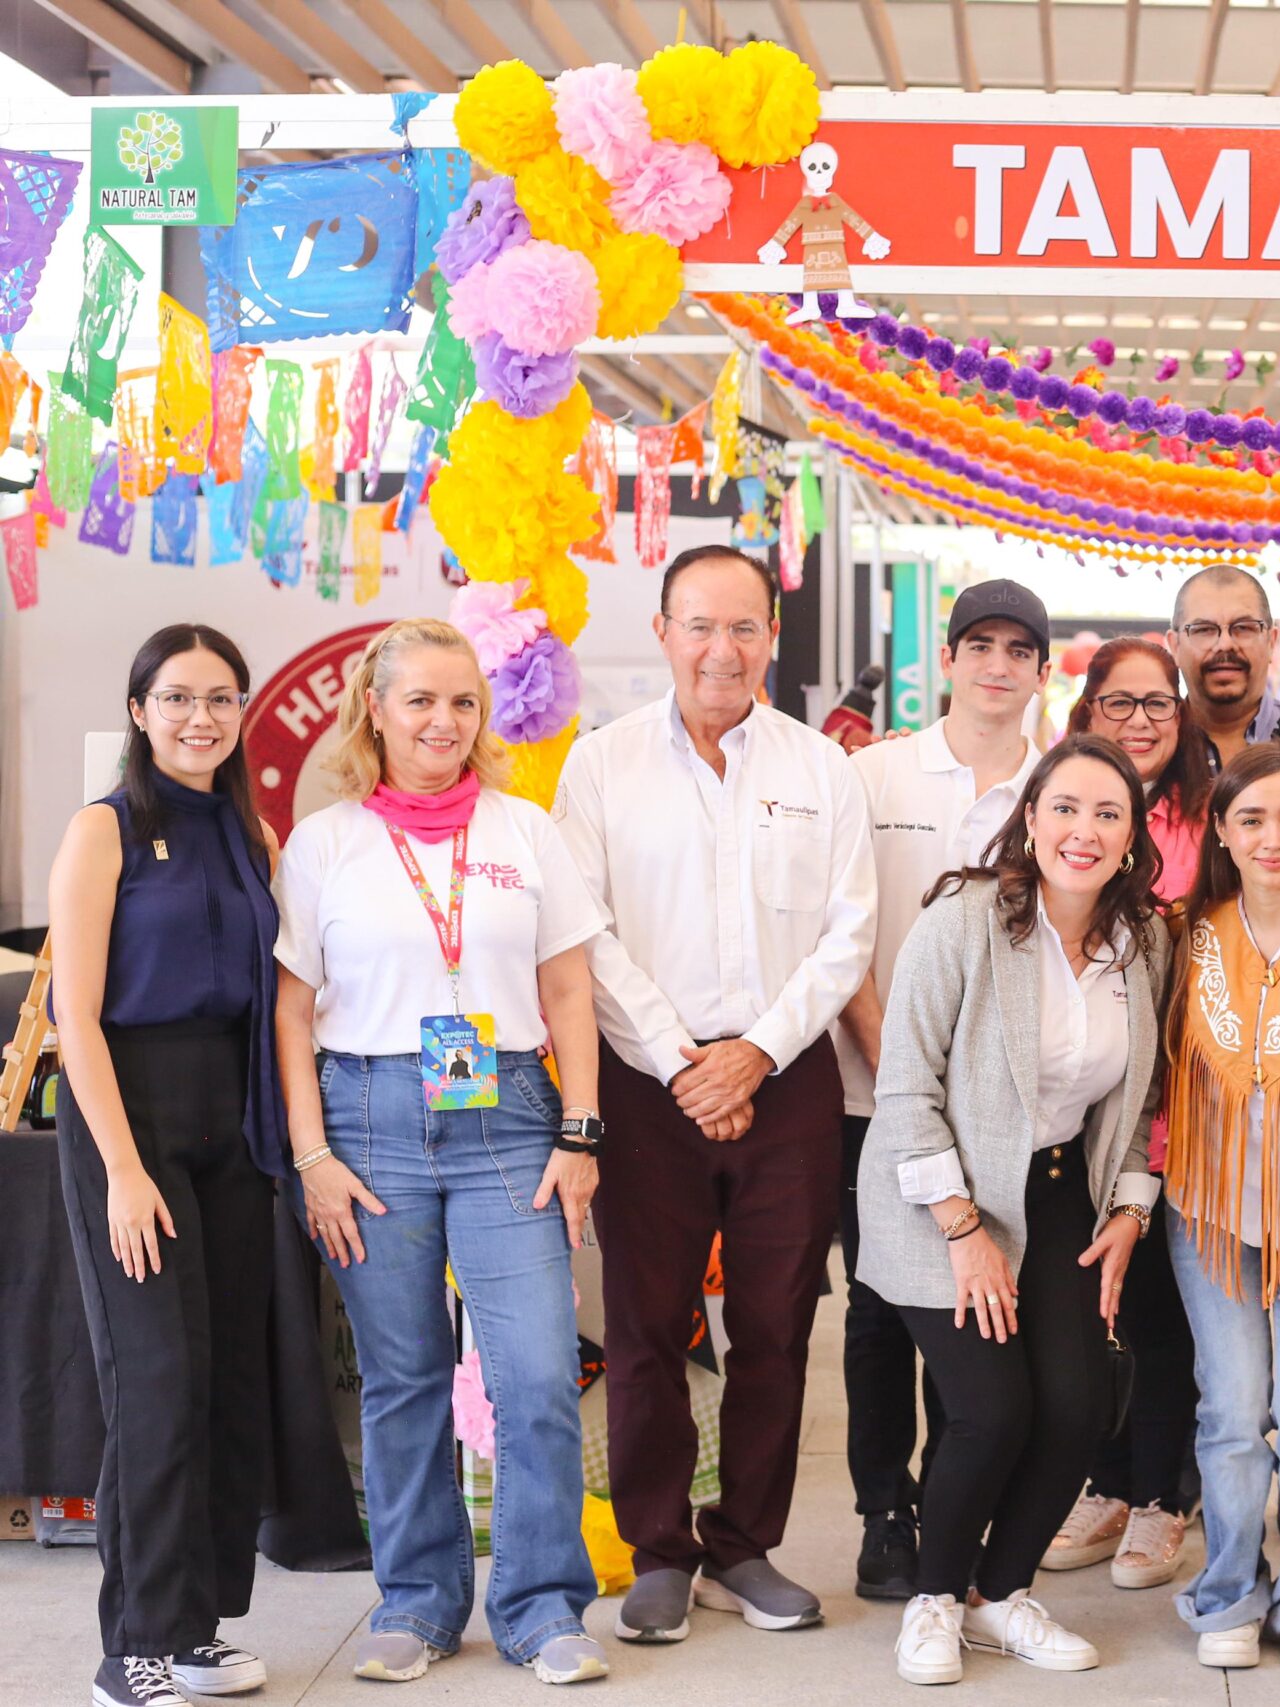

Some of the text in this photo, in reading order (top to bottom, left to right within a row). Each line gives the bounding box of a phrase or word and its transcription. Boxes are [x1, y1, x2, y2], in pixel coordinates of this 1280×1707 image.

[102, 189, 196, 207] NATURAL TAM
[989, 587, 1020, 606] alo
[486, 875, 525, 890] TEC
